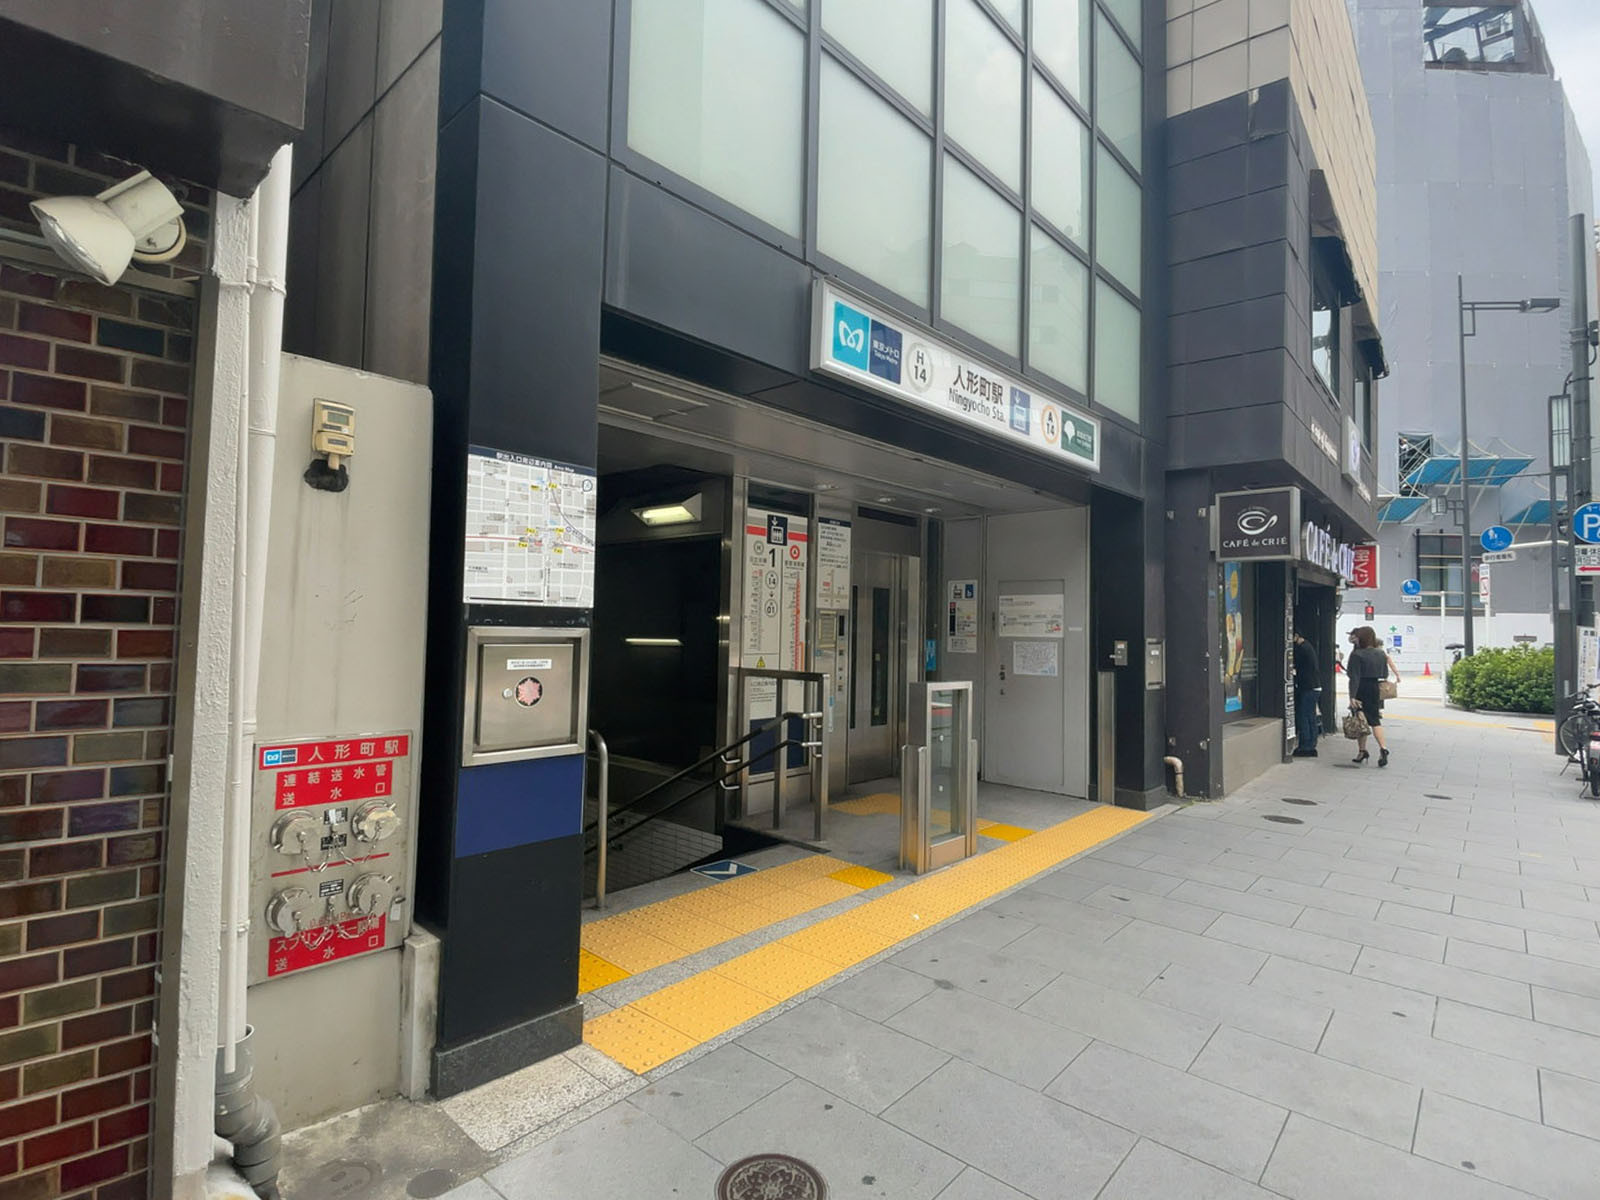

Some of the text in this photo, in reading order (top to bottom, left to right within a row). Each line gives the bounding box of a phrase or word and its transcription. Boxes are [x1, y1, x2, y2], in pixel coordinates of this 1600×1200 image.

[916, 350, 924, 365] H
[914, 365, 927, 383] 14
[953, 365, 1003, 405] 人形町駅
[949, 388, 1006, 423] Ningyocho Sta.
[1047, 411, 1053, 421] A
[1046, 423, 1055, 436] 14
[1583, 514, 1600, 538] P
[1222, 539, 1249, 548] CAFÉ
[1261, 536, 1288, 546] CRIÉ
[1306, 521, 1331, 571] CAFÉ
[768, 548, 775, 568] 1
[308, 740, 399, 762] 人形町駅
[283, 764, 386, 787] 連結送水管
[282, 782, 385, 806] 送水口
[274, 935, 378, 972] 送水口
